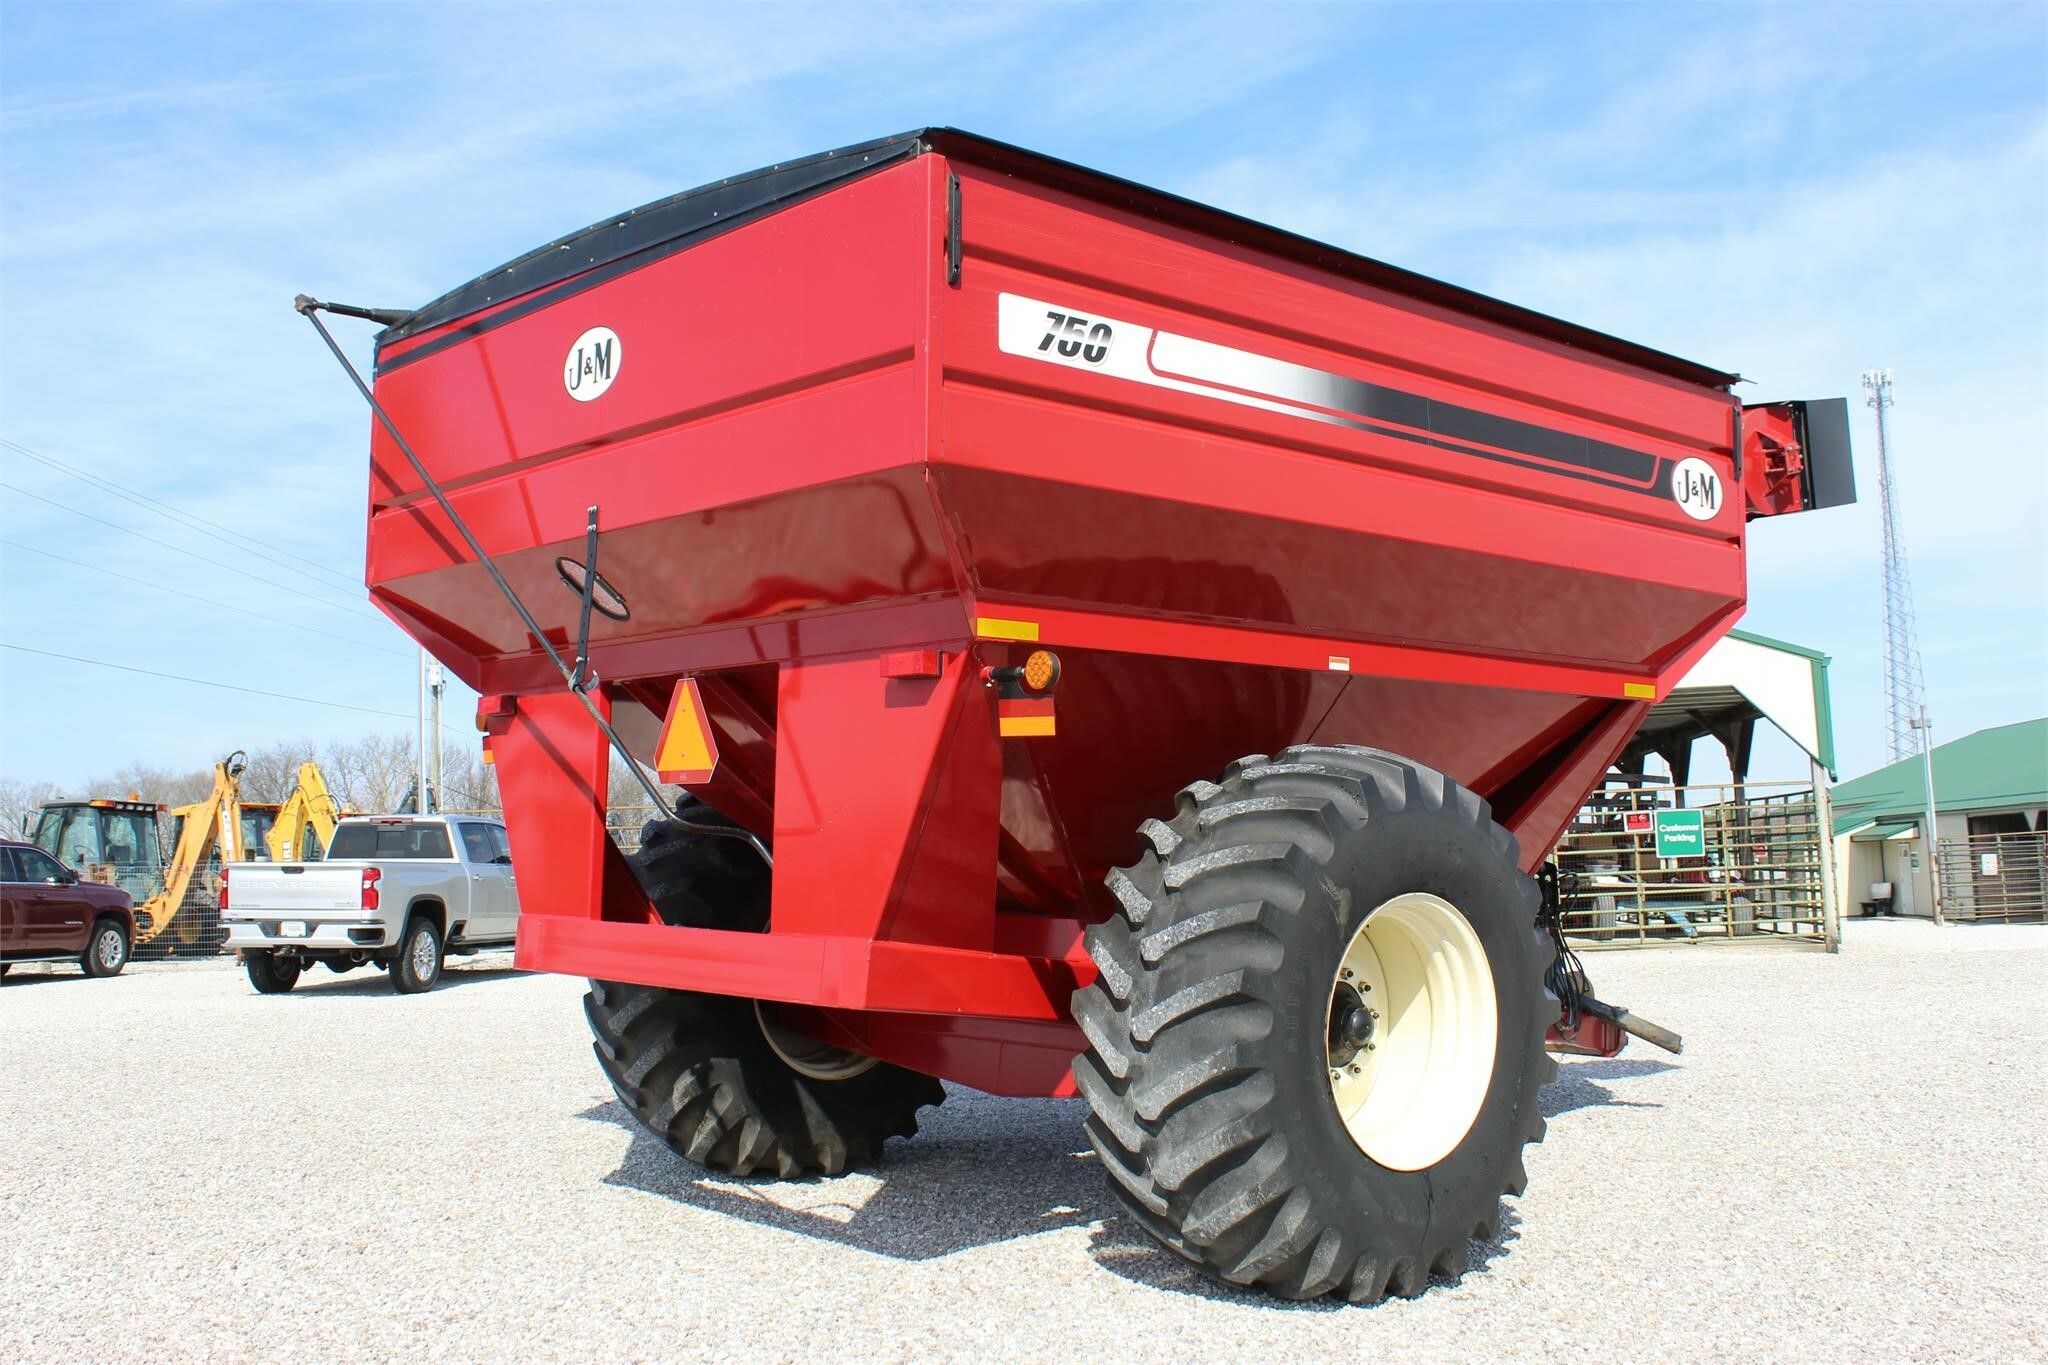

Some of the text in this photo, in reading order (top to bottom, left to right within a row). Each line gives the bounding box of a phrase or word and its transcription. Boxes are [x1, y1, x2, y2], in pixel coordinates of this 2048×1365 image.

[1038, 311, 1112, 363] 750
[569, 338, 613, 390] J&M
[1677, 469, 1715, 510] J&M
[1659, 824, 1700, 832] Customer
[1664, 834, 1696, 843] Parking
